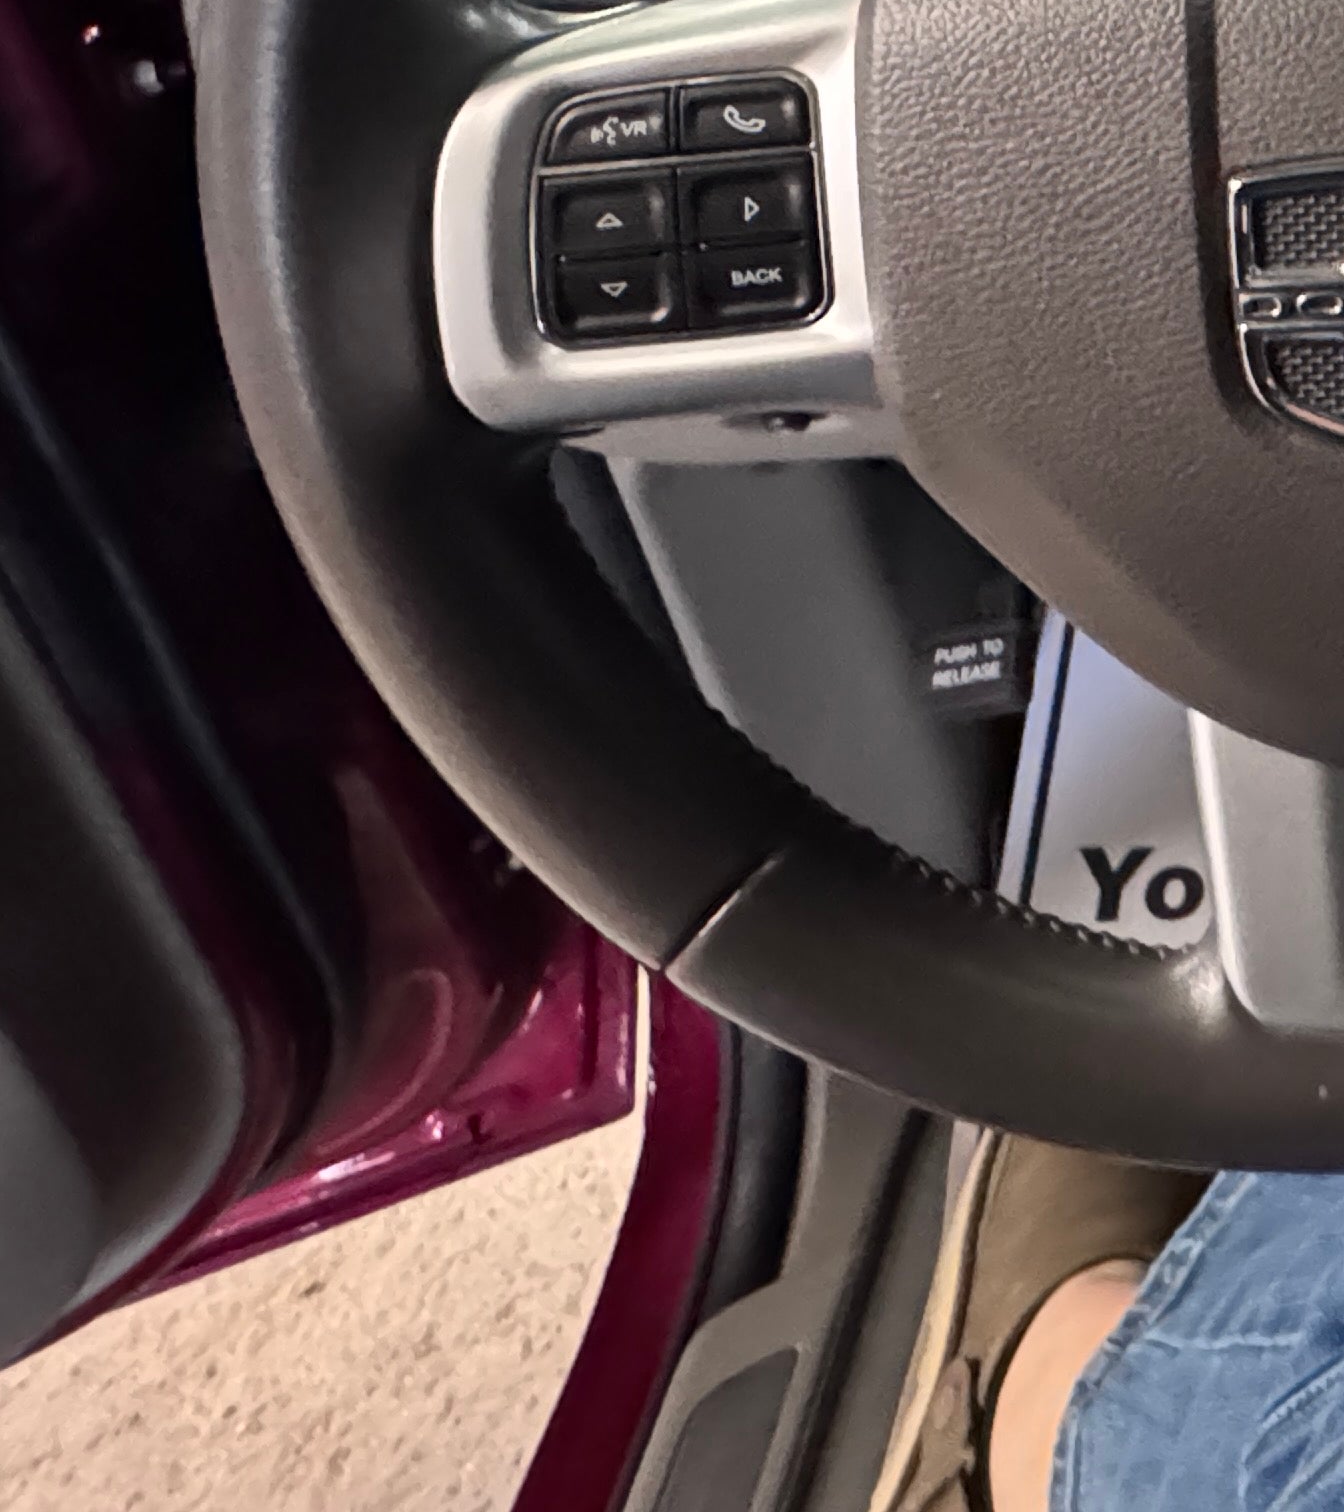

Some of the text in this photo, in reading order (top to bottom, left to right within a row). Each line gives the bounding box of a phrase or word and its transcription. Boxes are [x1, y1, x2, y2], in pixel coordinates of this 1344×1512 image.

[620, 118, 648, 136] VR
[731, 268, 782, 287] BACK
[1079, 847, 1205, 921] Yo
